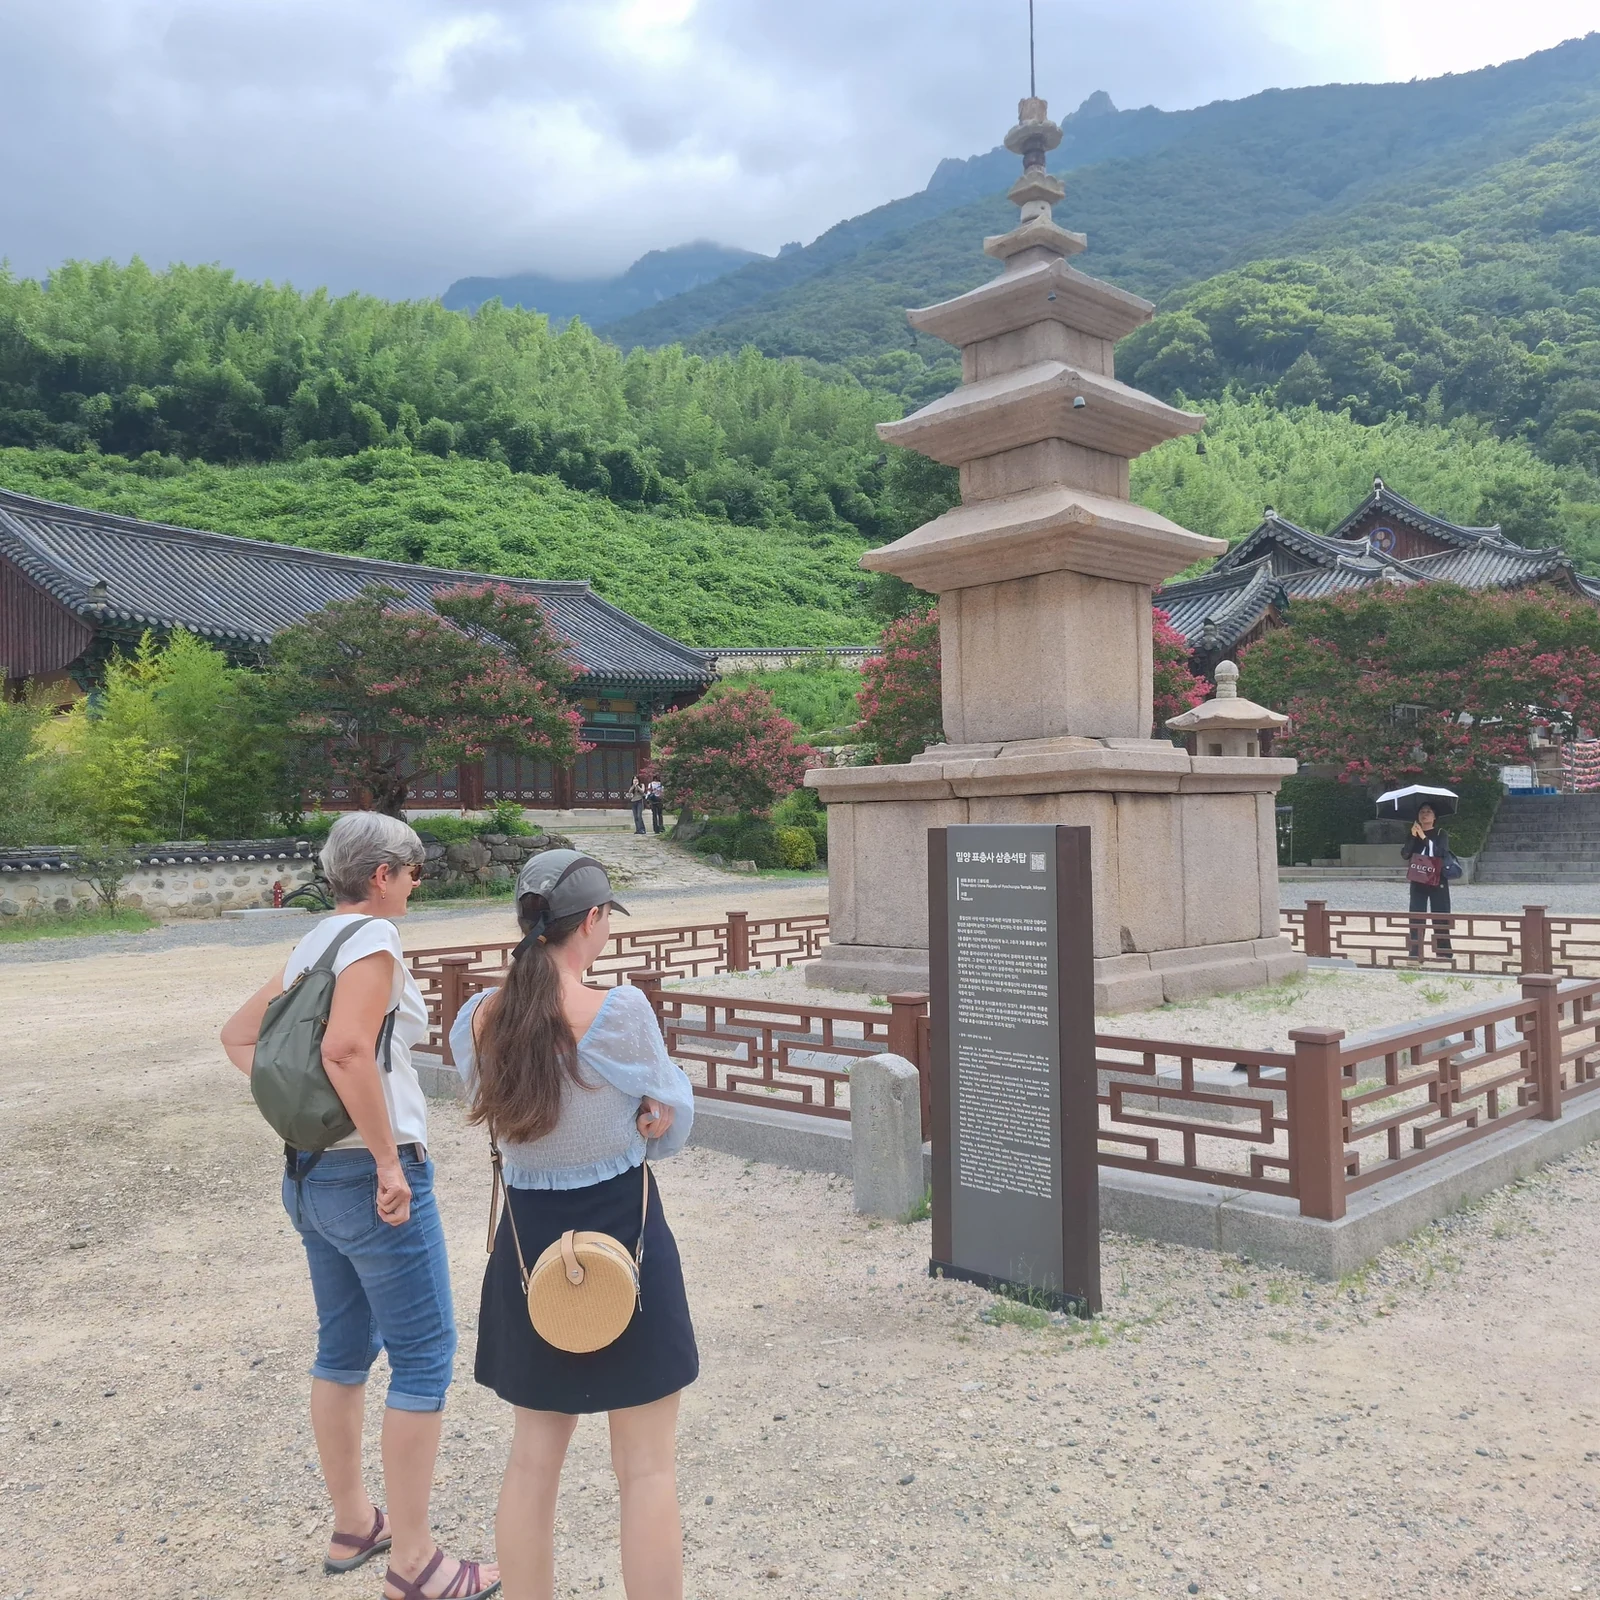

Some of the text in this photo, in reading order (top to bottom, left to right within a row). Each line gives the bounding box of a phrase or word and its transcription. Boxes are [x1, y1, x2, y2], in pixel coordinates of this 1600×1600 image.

[955, 851, 1027, 864] 밀양 표충사 삼층석탑
[1410, 863, 1436, 873] GUCCI
